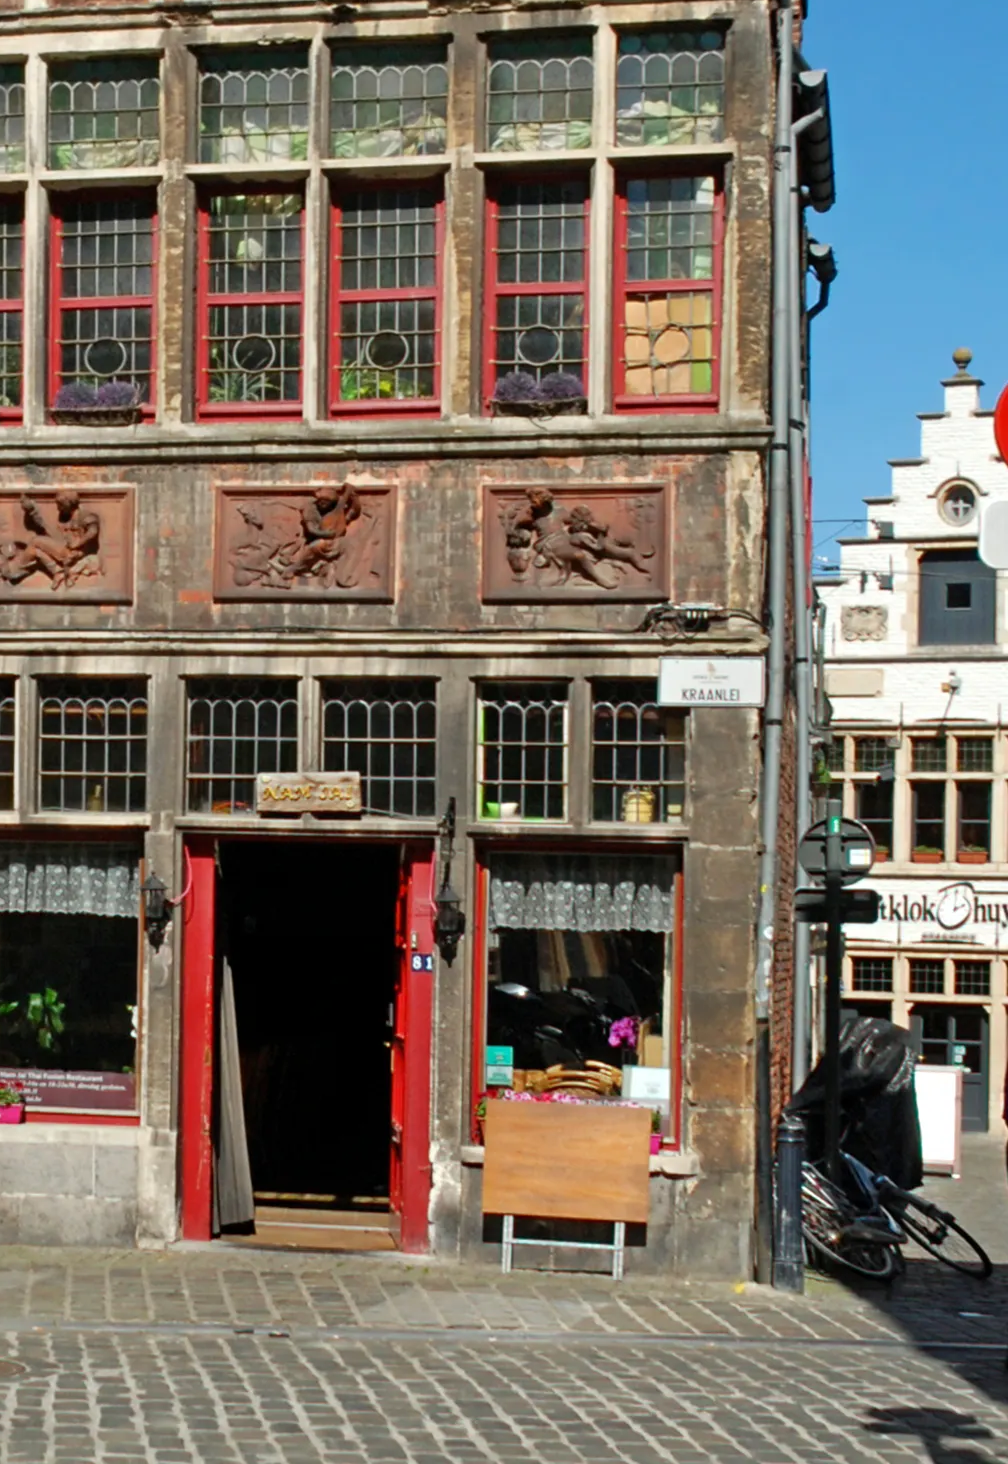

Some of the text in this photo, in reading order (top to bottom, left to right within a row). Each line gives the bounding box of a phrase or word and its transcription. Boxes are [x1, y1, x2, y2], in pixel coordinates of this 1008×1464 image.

[681, 688, 740, 701] KRAANLEI
[263, 784, 314, 801] NAM
[412, 955, 433, 970] 81
[66, 1074, 103, 1082] Restaurant
